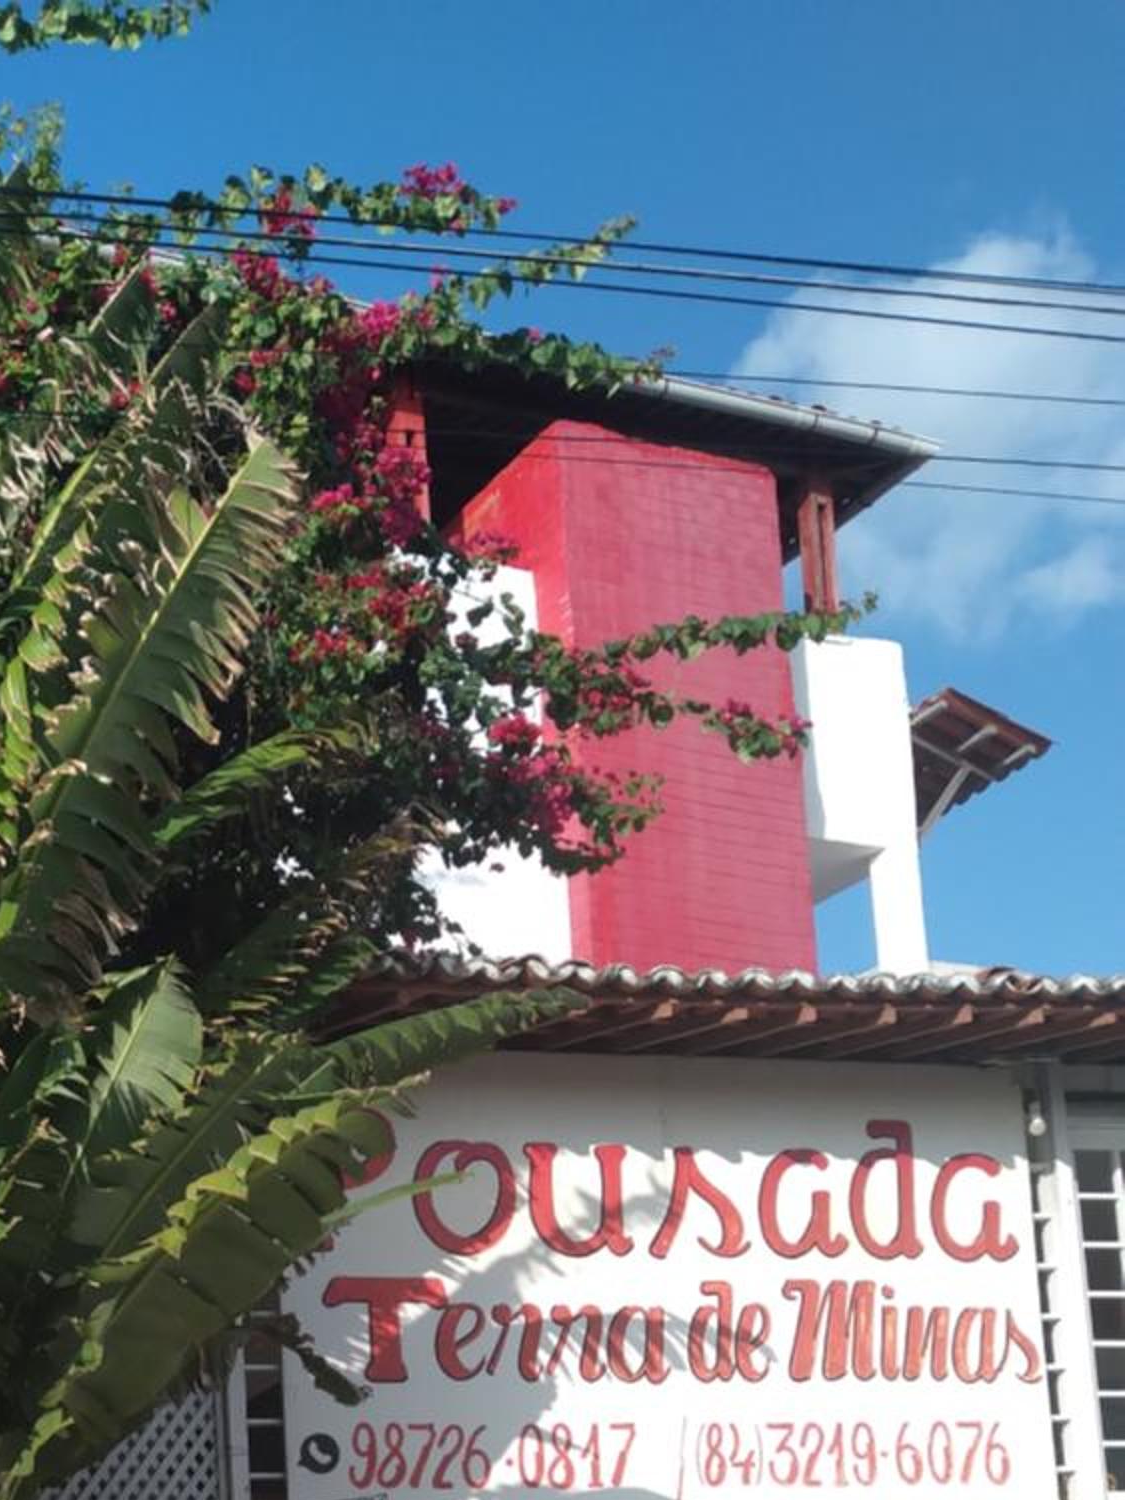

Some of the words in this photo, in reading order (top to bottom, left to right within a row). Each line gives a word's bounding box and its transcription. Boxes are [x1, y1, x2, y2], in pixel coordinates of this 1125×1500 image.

[321, 1275, 672, 1384] Terra
[686, 1279, 772, 1384] de
[780, 1279, 1044, 1384] Minas
